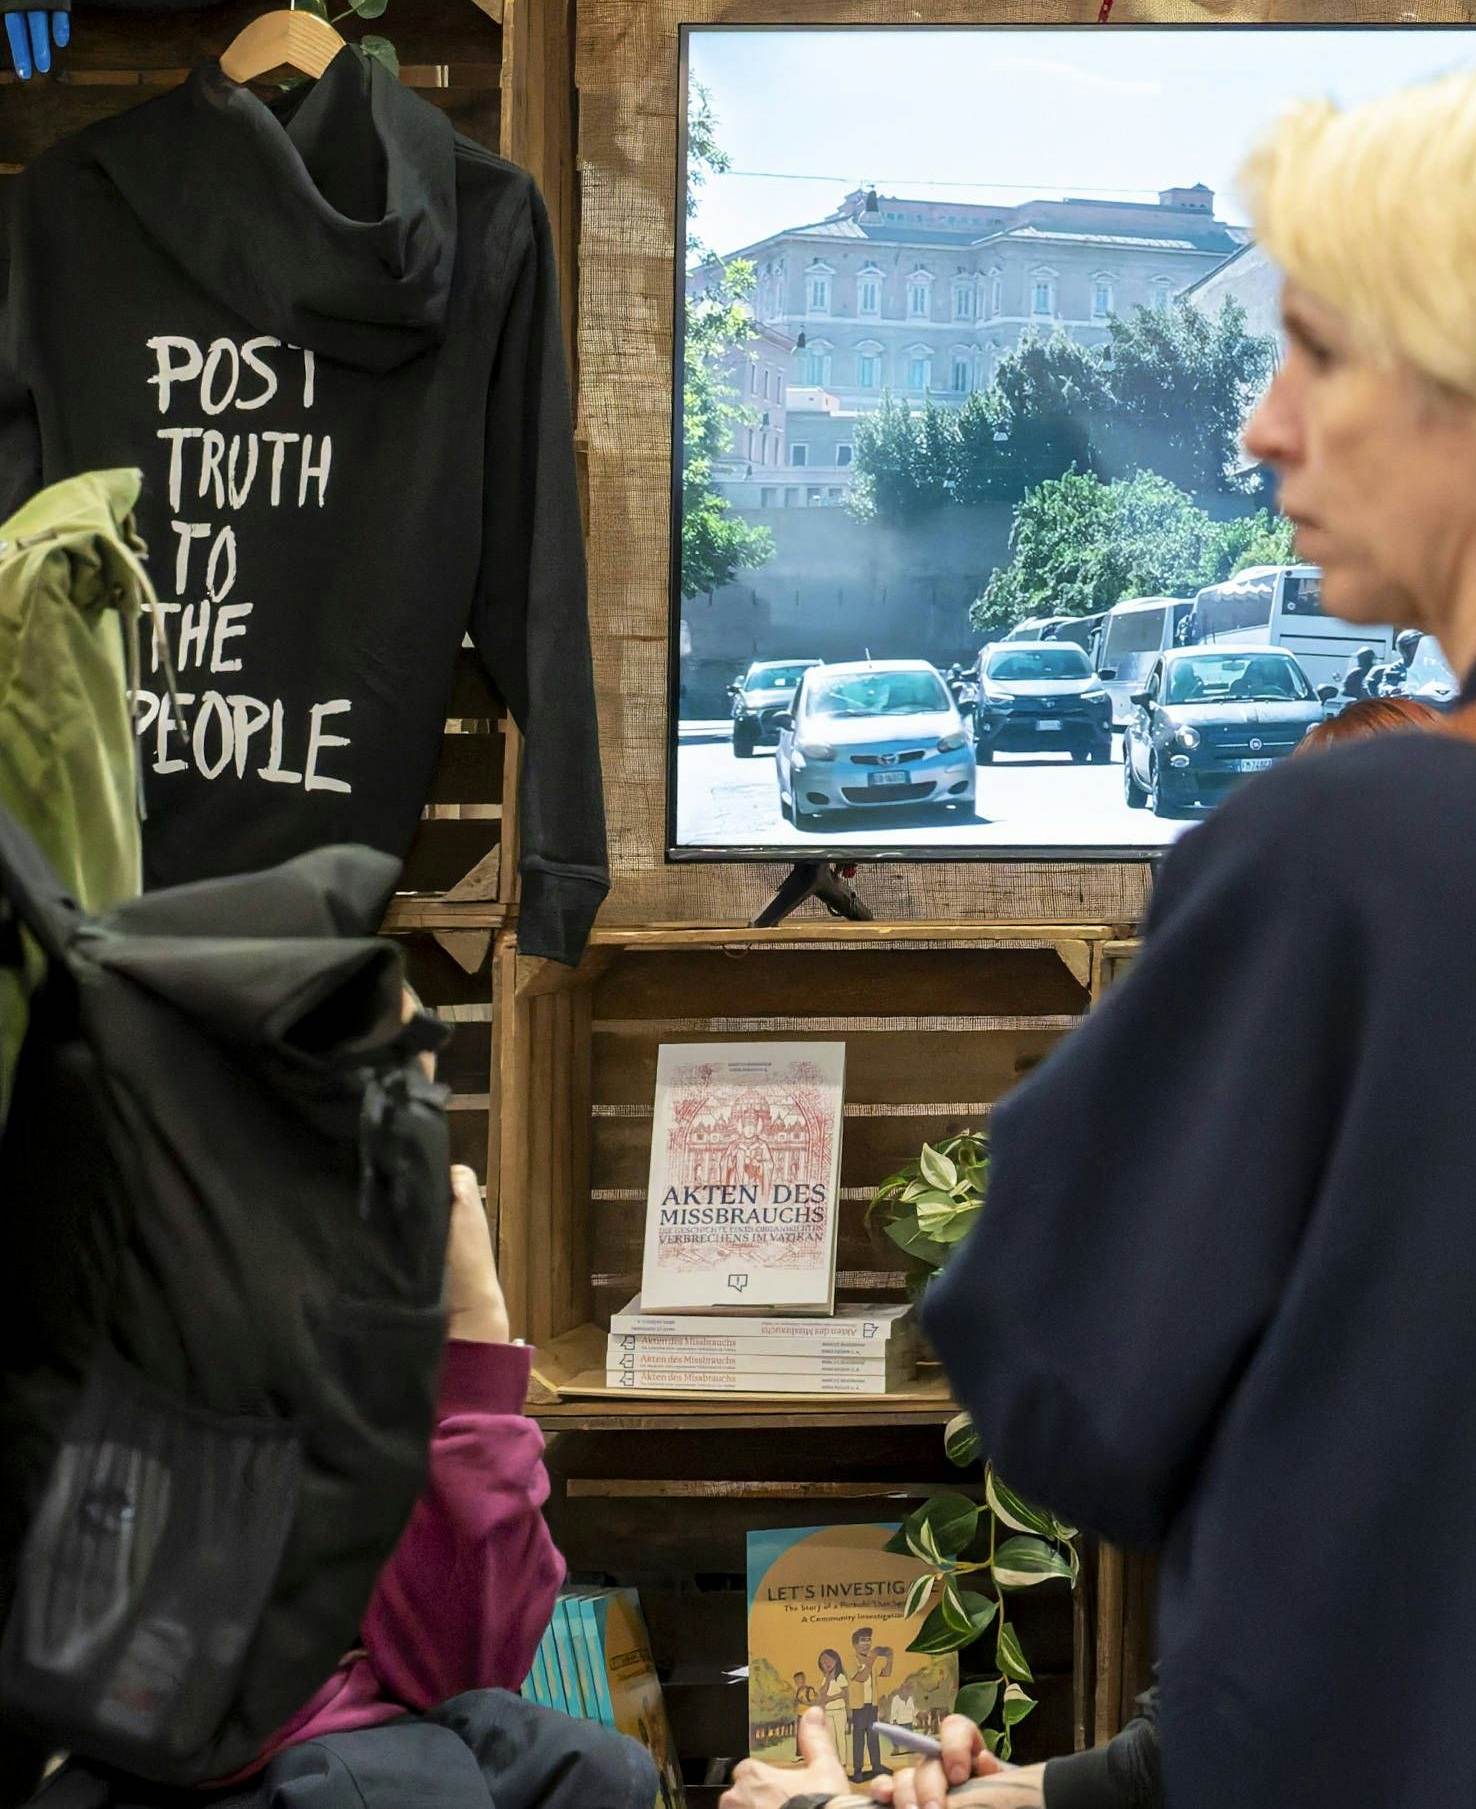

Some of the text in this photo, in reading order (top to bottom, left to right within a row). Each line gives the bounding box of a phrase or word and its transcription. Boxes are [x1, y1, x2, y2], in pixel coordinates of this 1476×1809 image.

[146, 335, 319, 413] POST
[156, 428, 333, 510] TRUTH
[170, 521, 237, 604] TO
[141, 601, 254, 674] THE
[127, 689, 352, 793] PEOPLE
[660, 1207, 824, 1225] MISSBRAUCHS
[662, 1184, 826, 1205] AKTEN DES
[659, 1232, 823, 1244] VERBRECHENS IM VATIKAN
[768, 1584, 815, 1601] LET'S
[810, 1614, 855, 1623] Community
